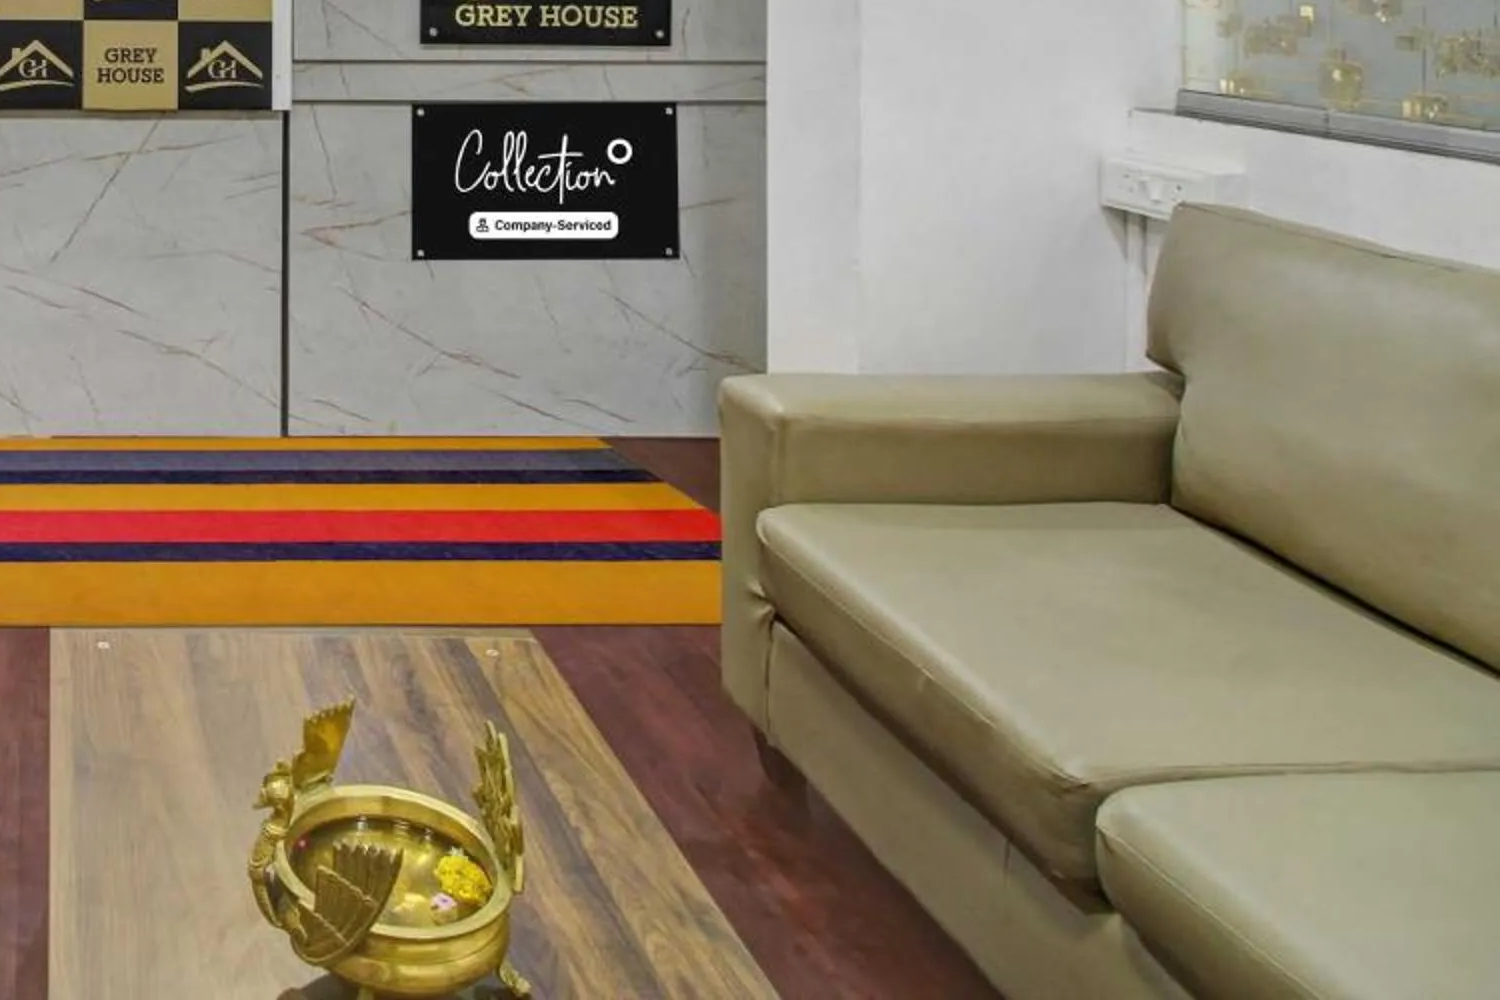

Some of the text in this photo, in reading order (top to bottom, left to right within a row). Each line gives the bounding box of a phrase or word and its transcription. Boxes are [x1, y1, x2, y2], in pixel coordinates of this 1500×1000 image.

[454, 5, 639, 28] GREY HOUSE
[104, 48, 158, 64] GREY
[97, 67, 165, 84] HOUSE
[454, 129, 617, 205] Collection
[494, 219, 612, 233] Company-Serviced
